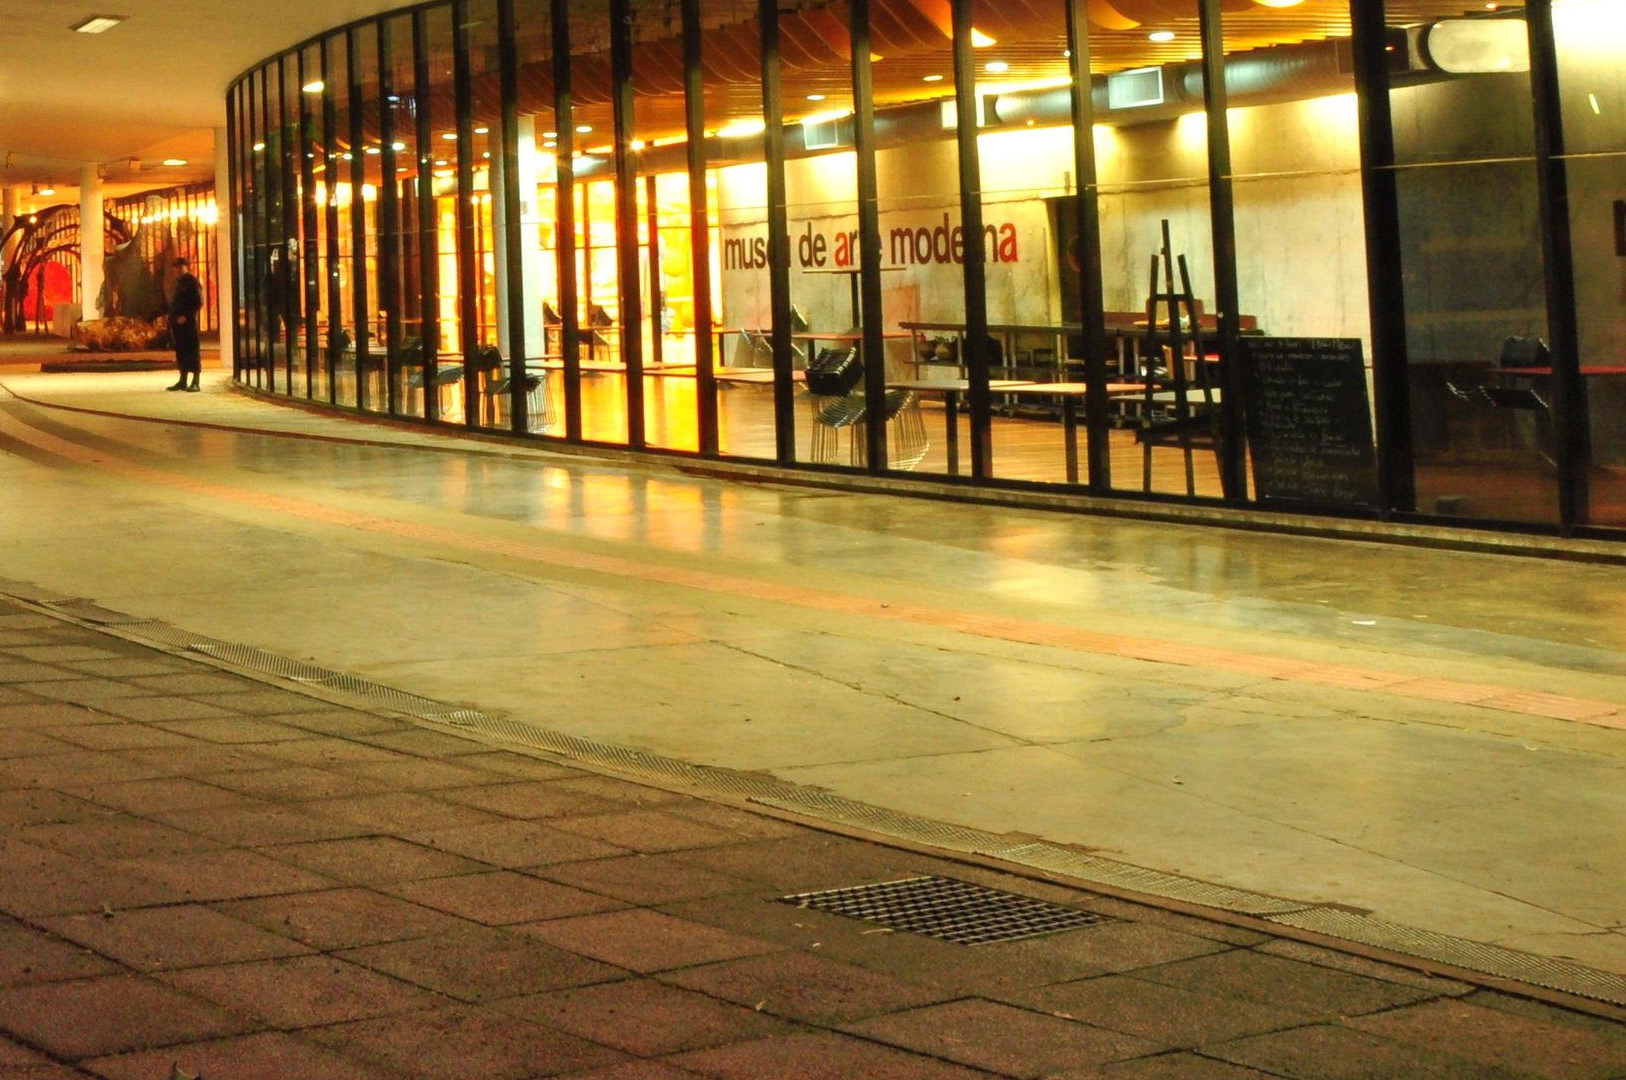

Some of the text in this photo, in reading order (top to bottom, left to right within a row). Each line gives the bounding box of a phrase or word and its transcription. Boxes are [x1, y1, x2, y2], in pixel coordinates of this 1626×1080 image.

[724, 211, 1018, 270] mus de ar modena
